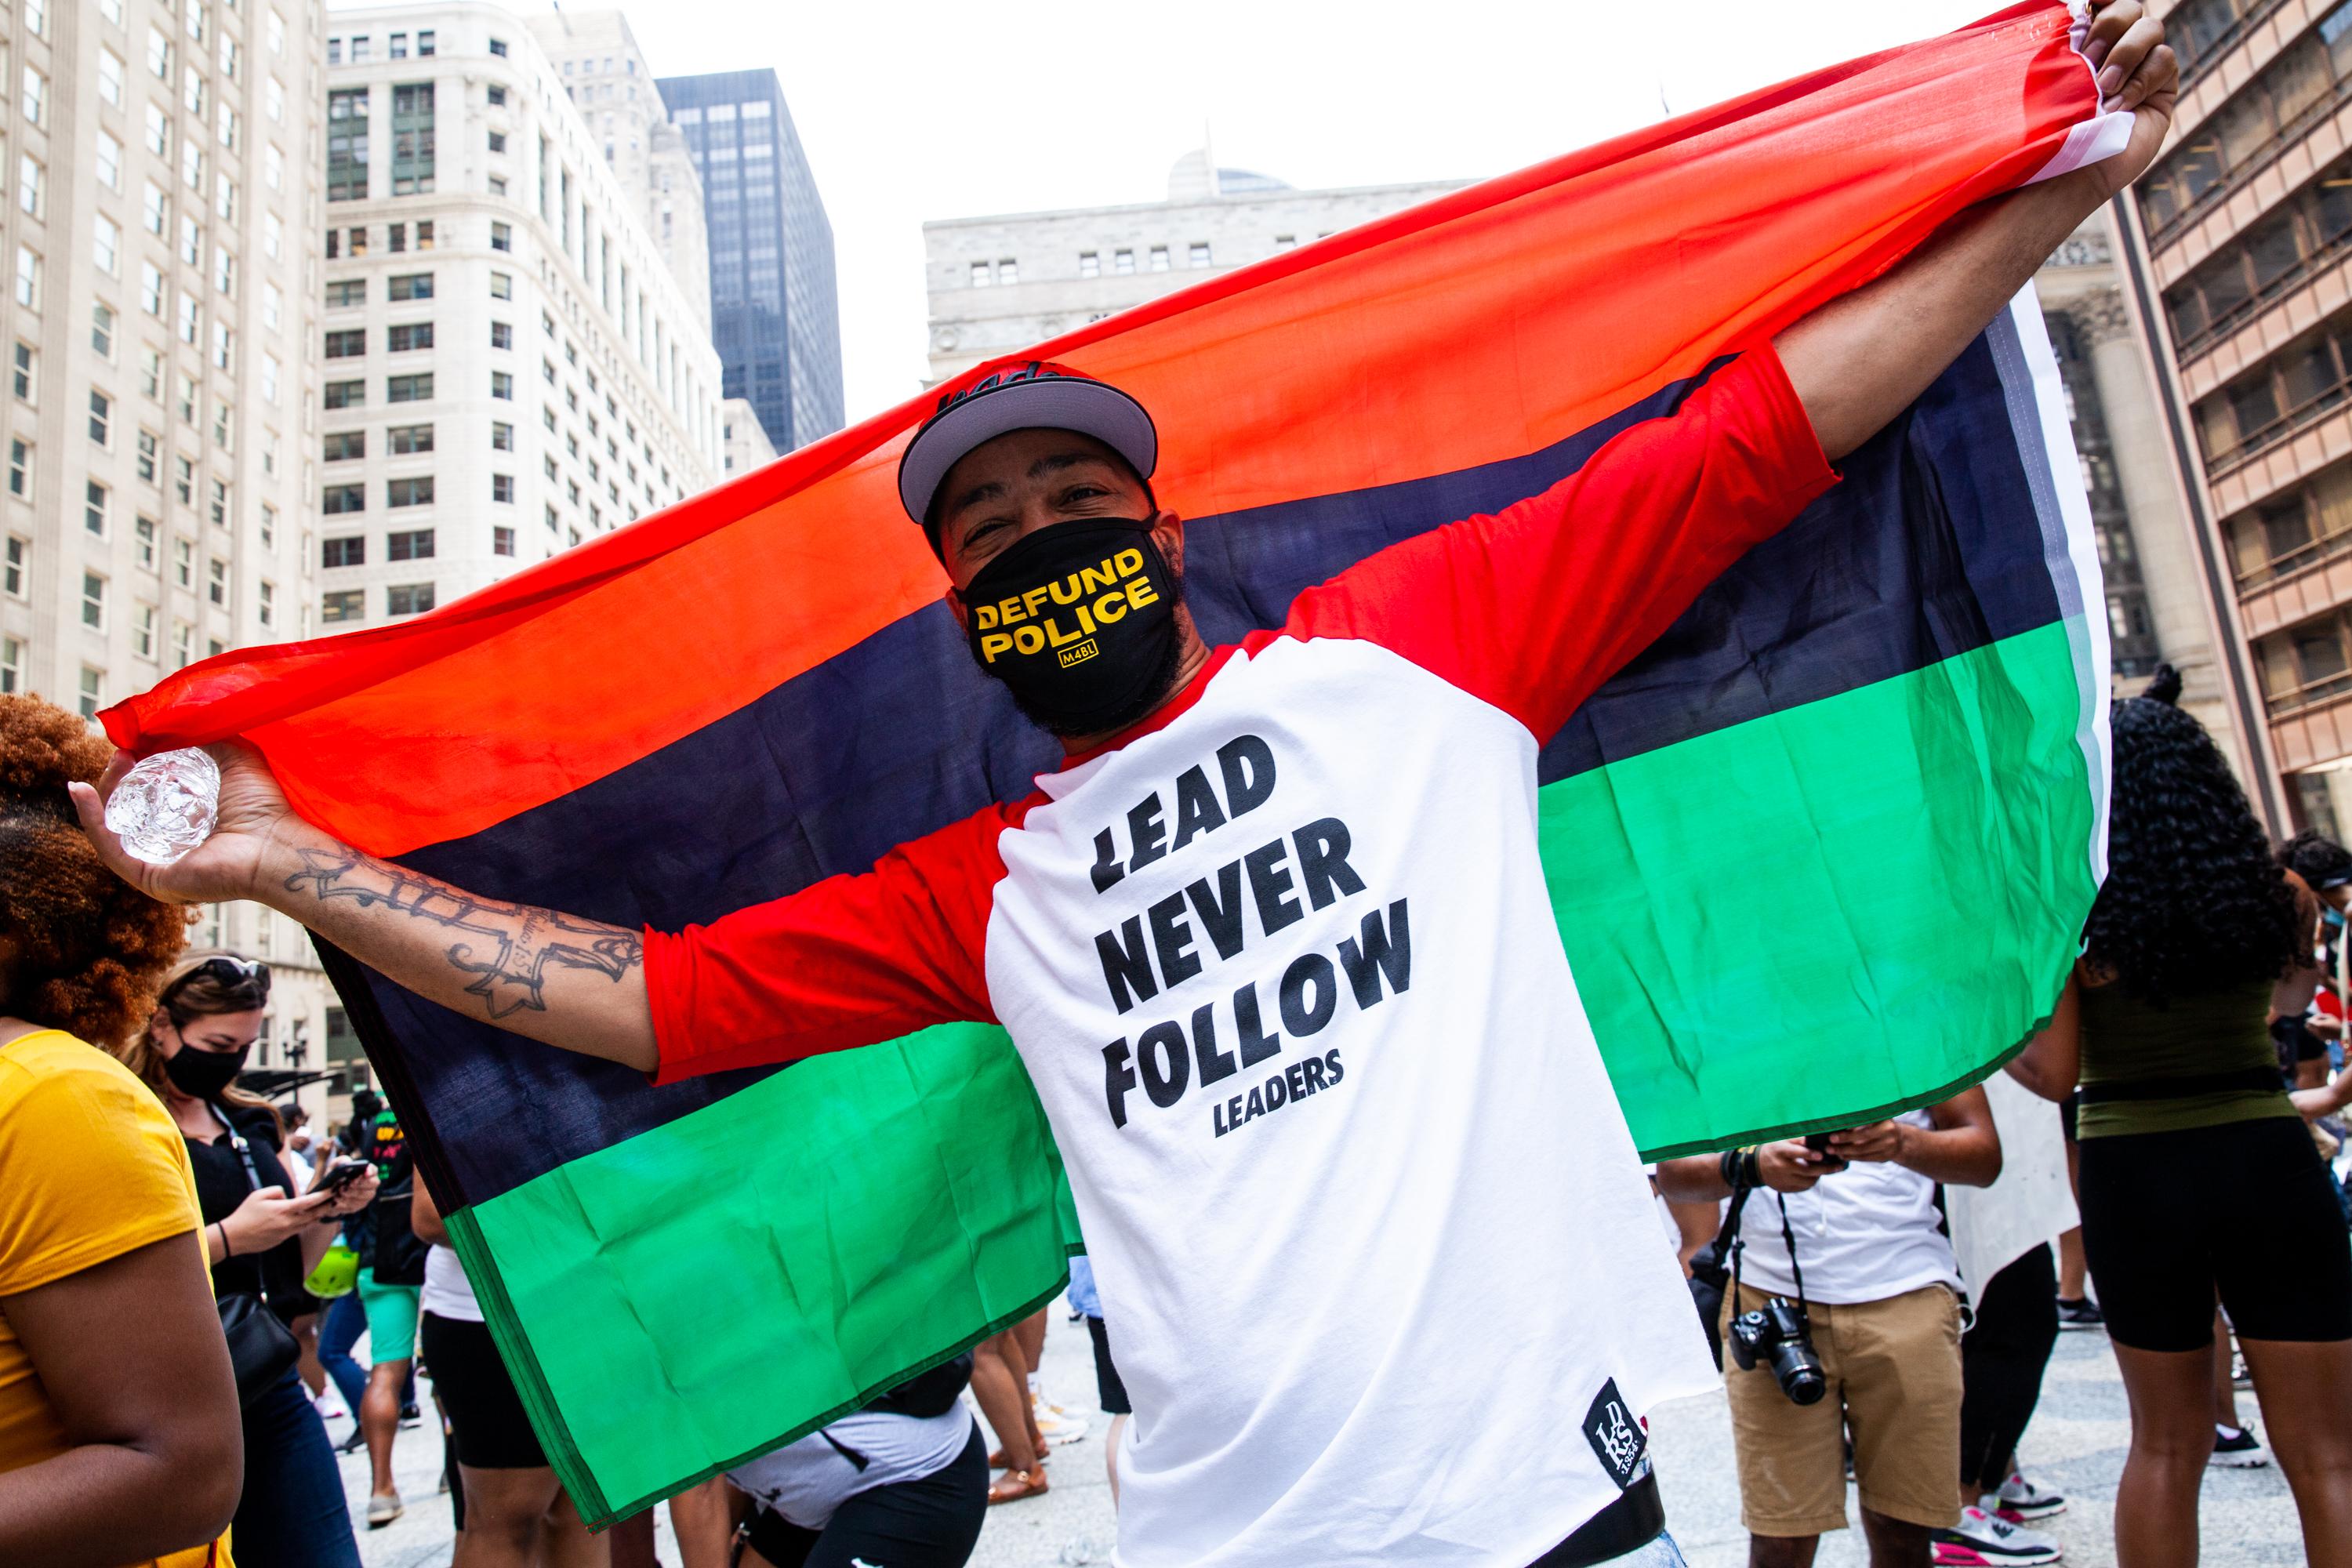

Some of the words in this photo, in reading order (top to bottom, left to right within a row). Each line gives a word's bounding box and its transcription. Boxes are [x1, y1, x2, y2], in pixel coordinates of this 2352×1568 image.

[975, 548, 1144, 630] DEFUND
[981, 576, 1160, 663] POLICE
[1062, 644, 1095, 665] M4BL
[1091, 735, 1276, 895] LEAD
[1094, 818, 1367, 1015] NEVER
[1101, 898, 1411, 1130] FOLLOW
[1214, 1048, 1344, 1138] LEADERS
